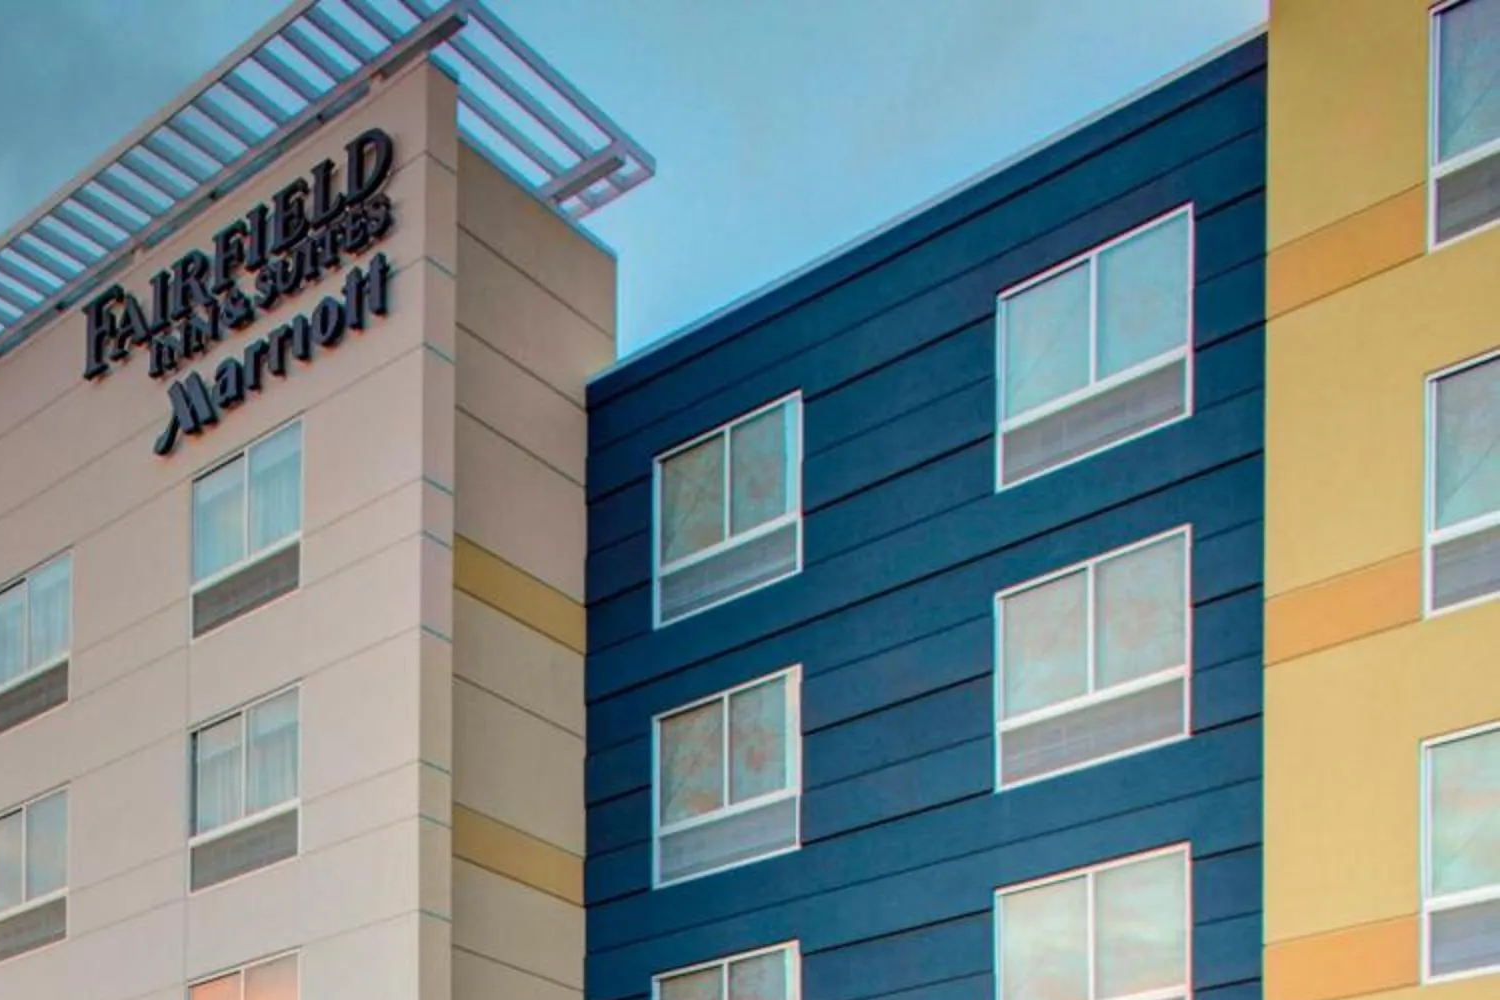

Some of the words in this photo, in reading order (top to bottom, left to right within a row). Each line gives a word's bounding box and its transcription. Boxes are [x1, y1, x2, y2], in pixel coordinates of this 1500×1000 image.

[82, 127, 394, 381] FAIRFIELD
[153, 252, 391, 456] Marriott
[255, 193, 394, 311] SUITES
